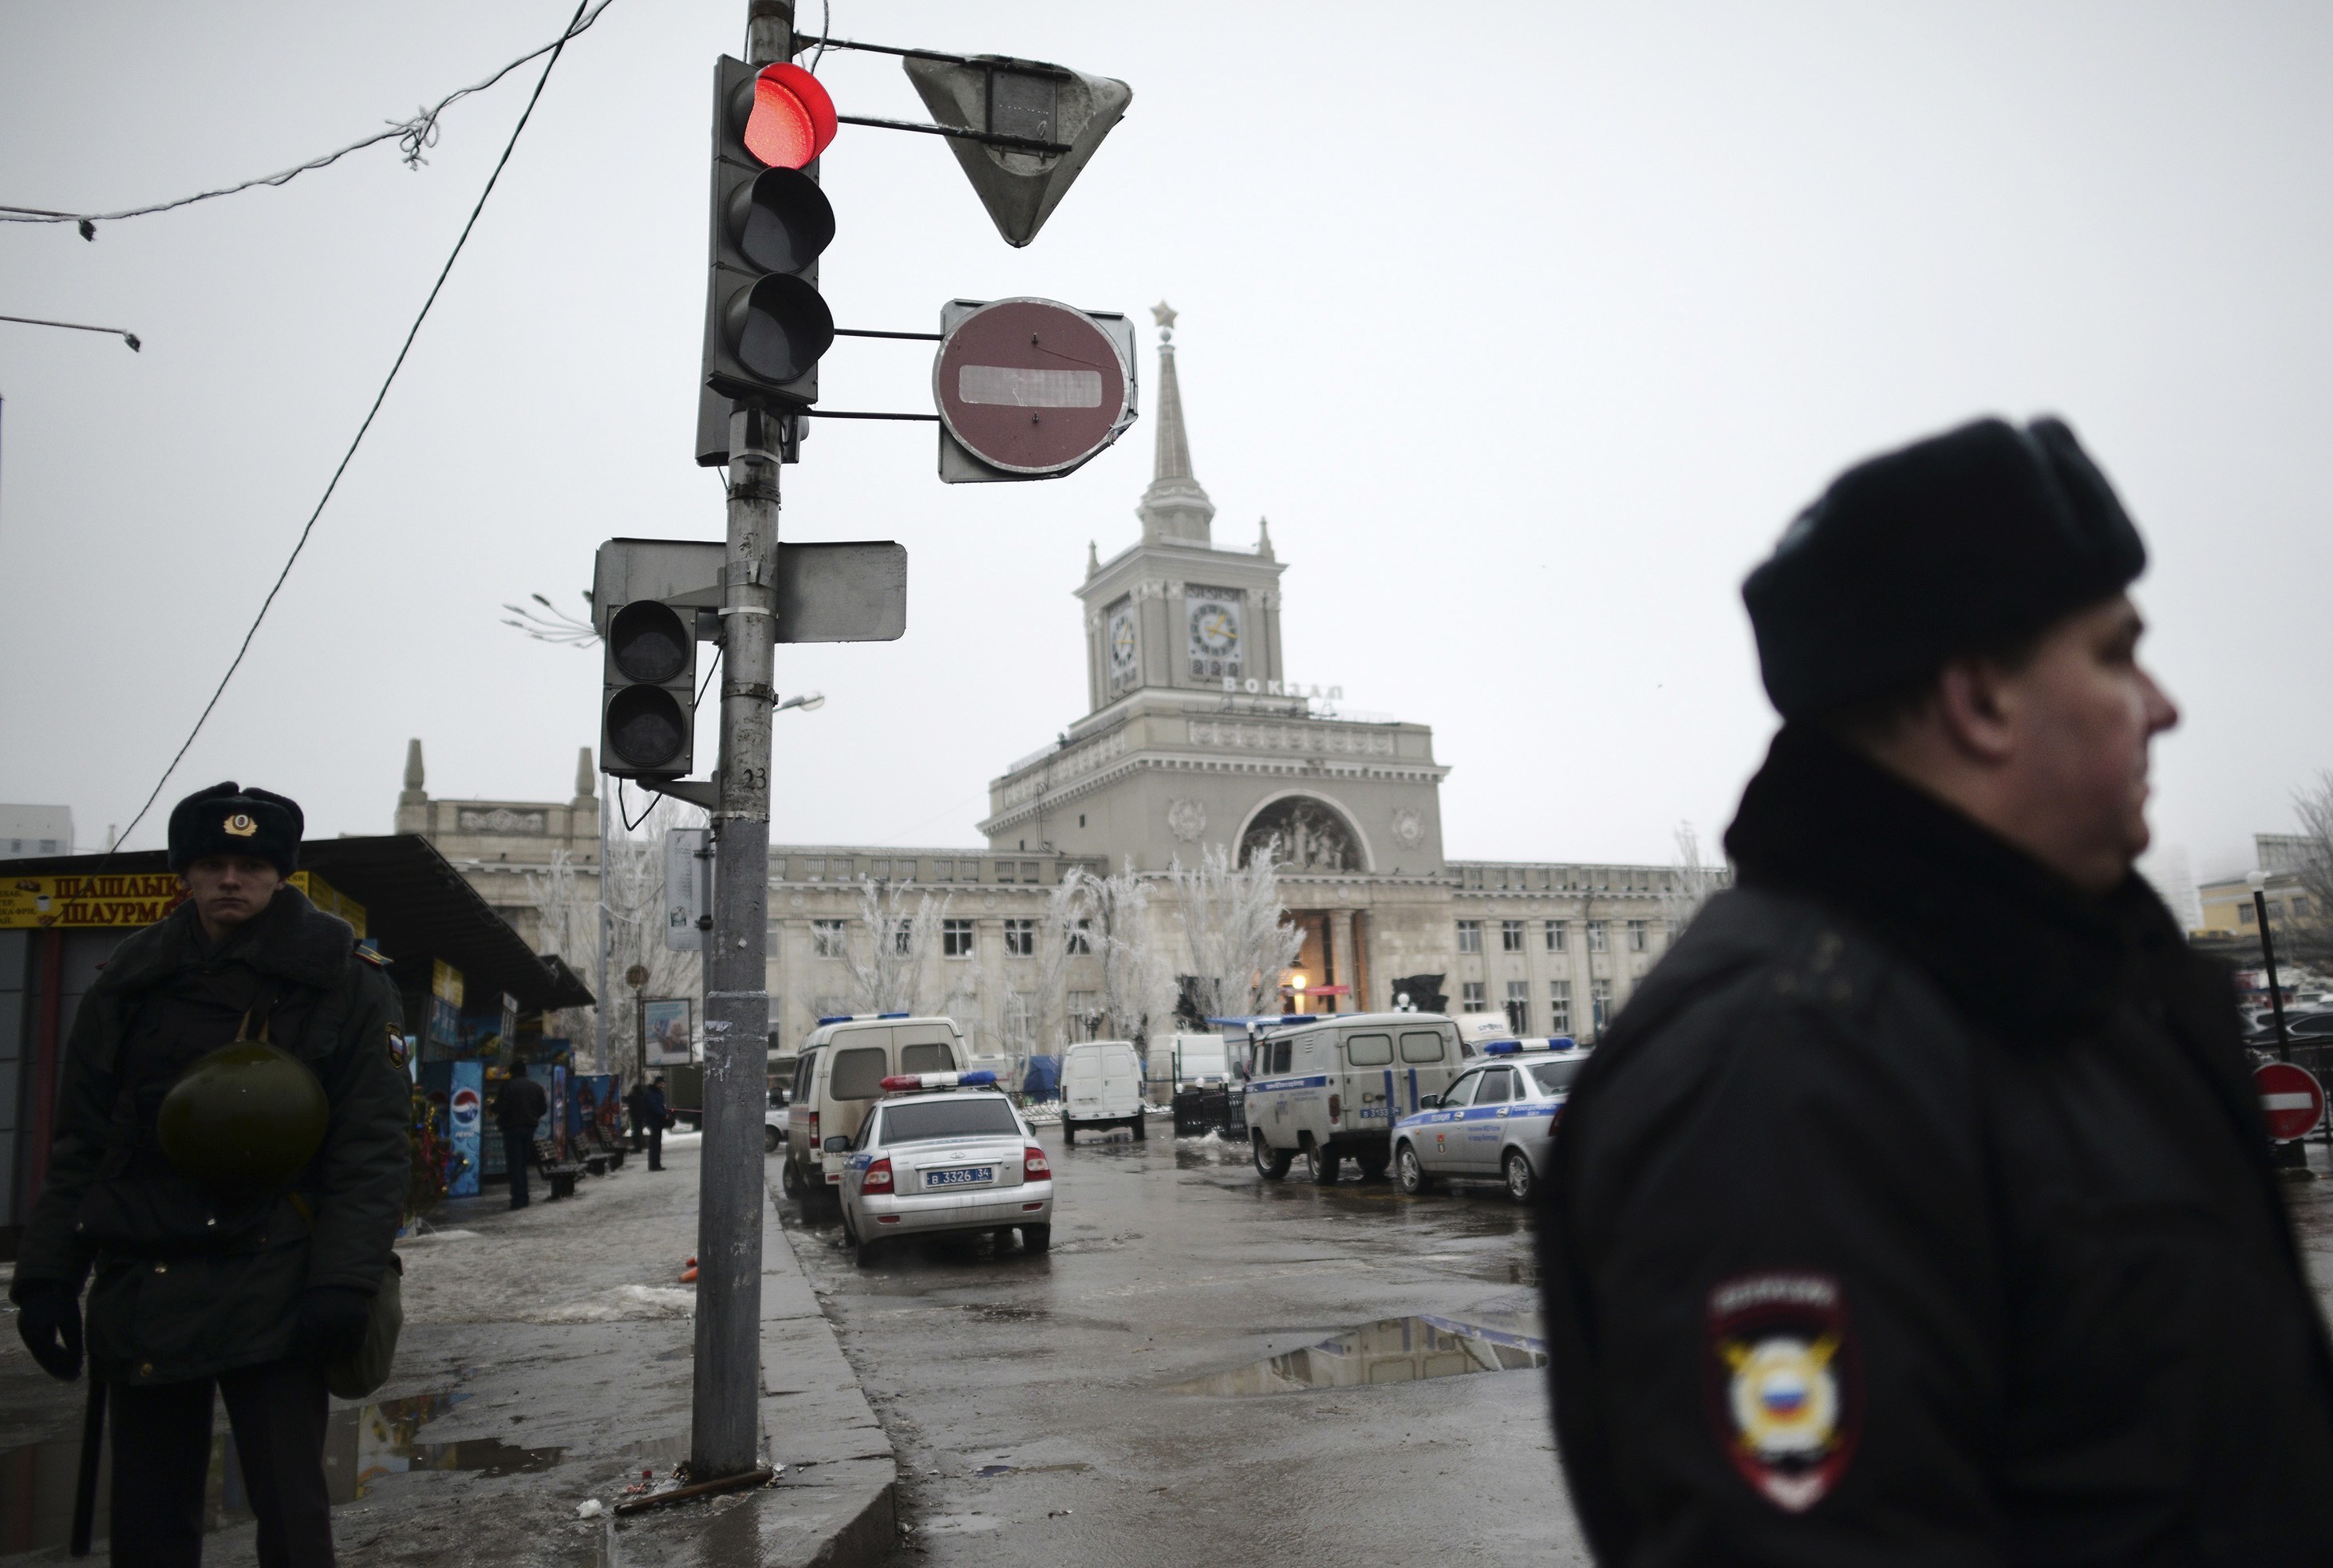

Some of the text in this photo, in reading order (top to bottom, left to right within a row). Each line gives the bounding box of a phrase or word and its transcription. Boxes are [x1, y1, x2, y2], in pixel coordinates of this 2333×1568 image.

[1222, 676, 1344, 700] ВОКЗАЛ
[743, 768, 767, 790] 23
[53, 877, 180, 899] ШАШЛЫК
[943, 1170, 971, 1183] 3326
[977, 1168, 989, 1177] 34
